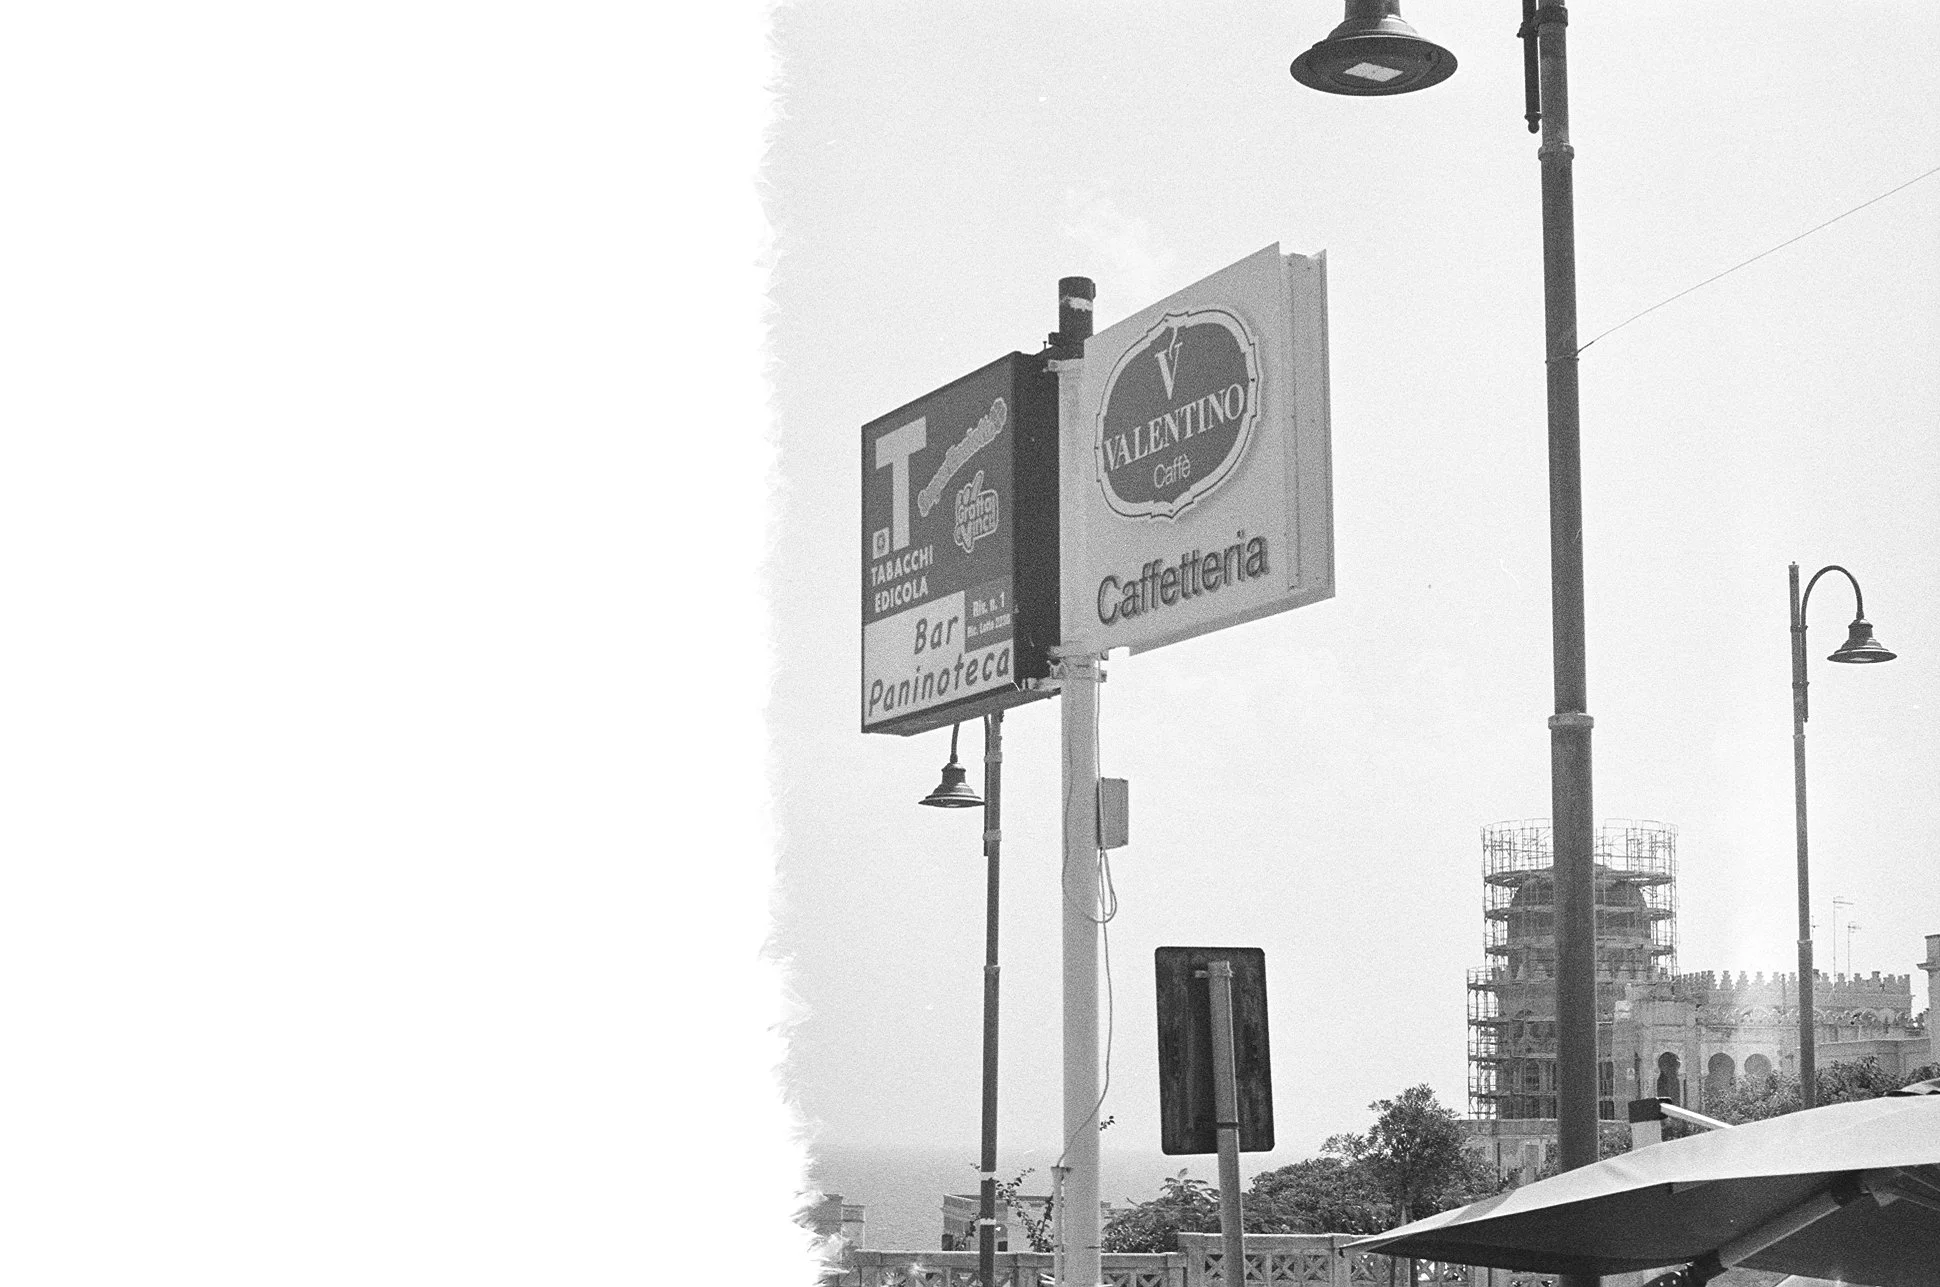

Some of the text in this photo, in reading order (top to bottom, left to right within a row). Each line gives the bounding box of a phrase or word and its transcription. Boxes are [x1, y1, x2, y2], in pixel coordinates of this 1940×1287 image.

[1155, 327, 1183, 400] V
[1103, 383, 1245, 472] VALENTINO
[1153, 454, 1191, 490] Caffè
[871, 544, 934, 587] TABACCHI
[1098, 530, 1271, 626] Caffetteria
[874, 576, 929, 614] EDICOLA
[1000, 592, 1005, 608] 1
[914, 613, 959, 655] Bar
[868, 647, 1010, 717] Paninoteca
